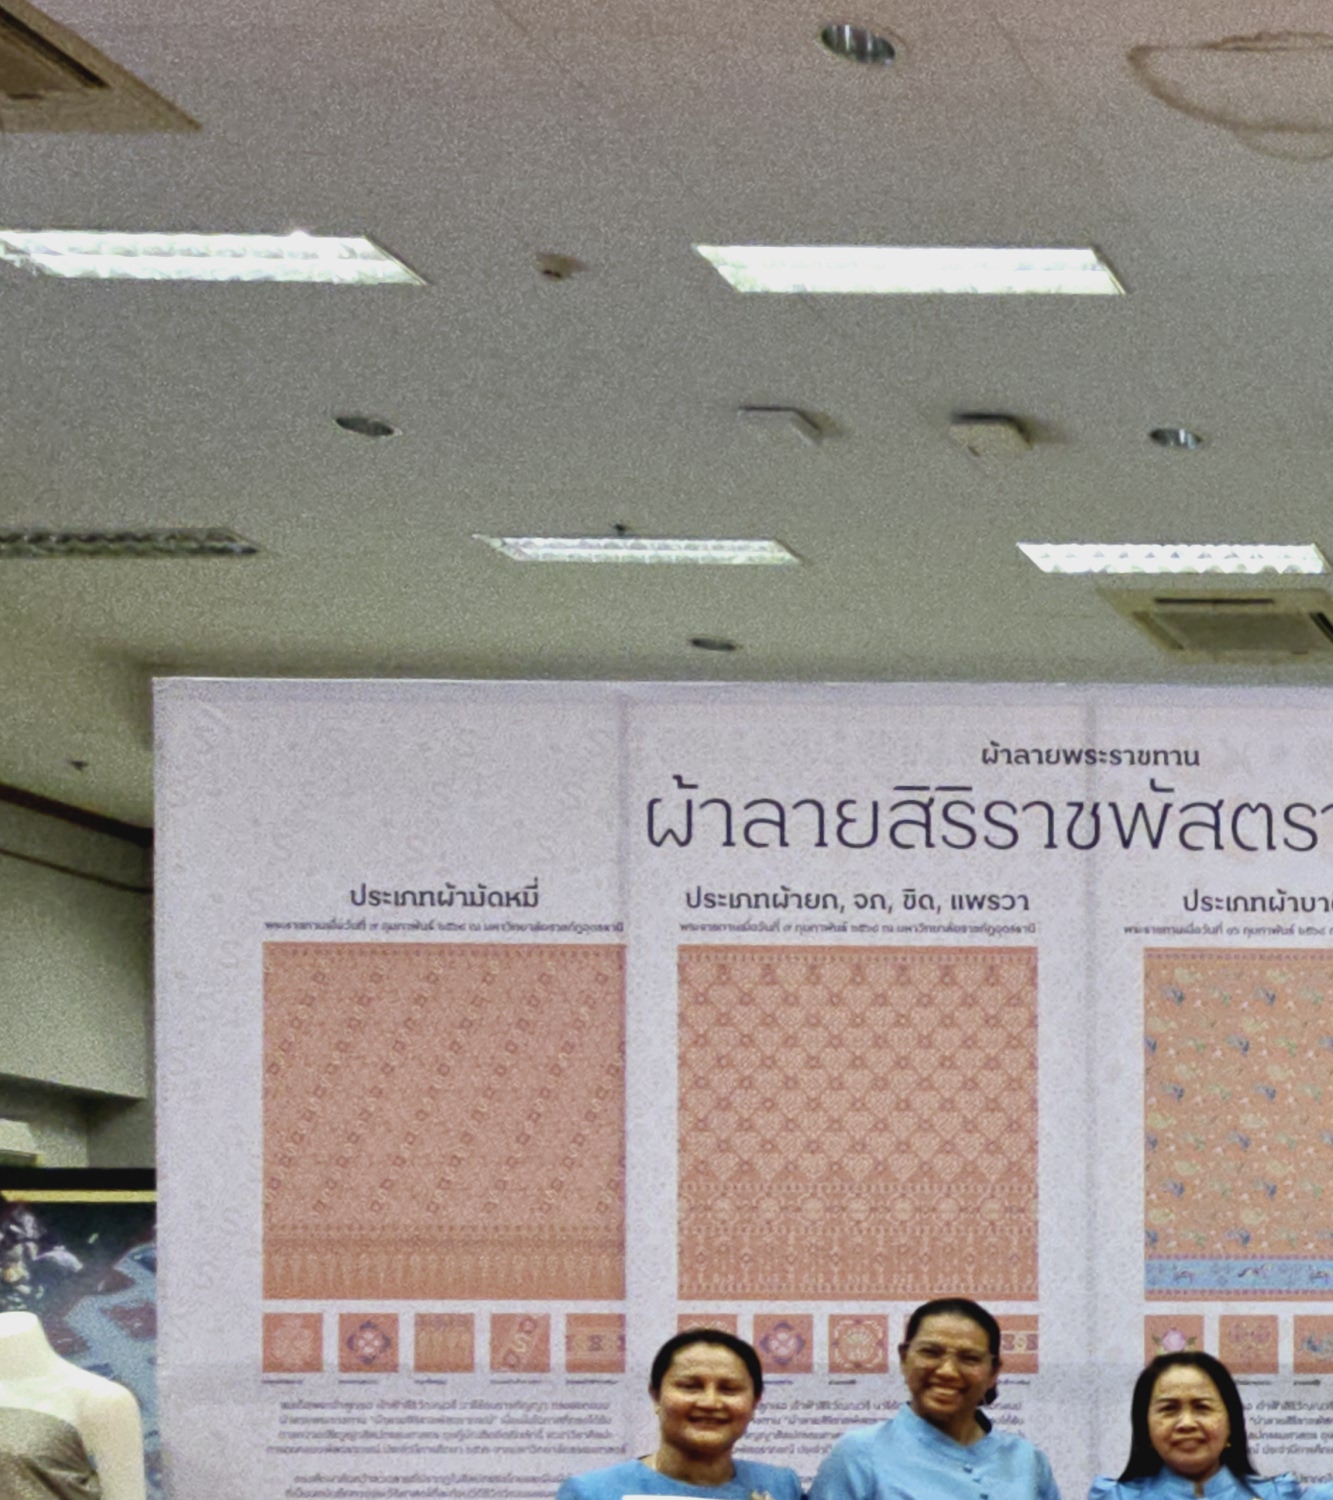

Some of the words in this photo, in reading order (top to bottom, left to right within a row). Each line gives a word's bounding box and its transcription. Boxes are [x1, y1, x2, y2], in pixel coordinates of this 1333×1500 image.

[981, 742, 1200, 768] ผ้าลายพระราชทาน
[350, 877, 539, 907] ประเภทผ้ามัดหมี่
[686, 885, 844, 913] ประเภทผ้ายก,
[854, 889, 892, 913] จก,
[951, 890, 1030, 912] แพรวา
